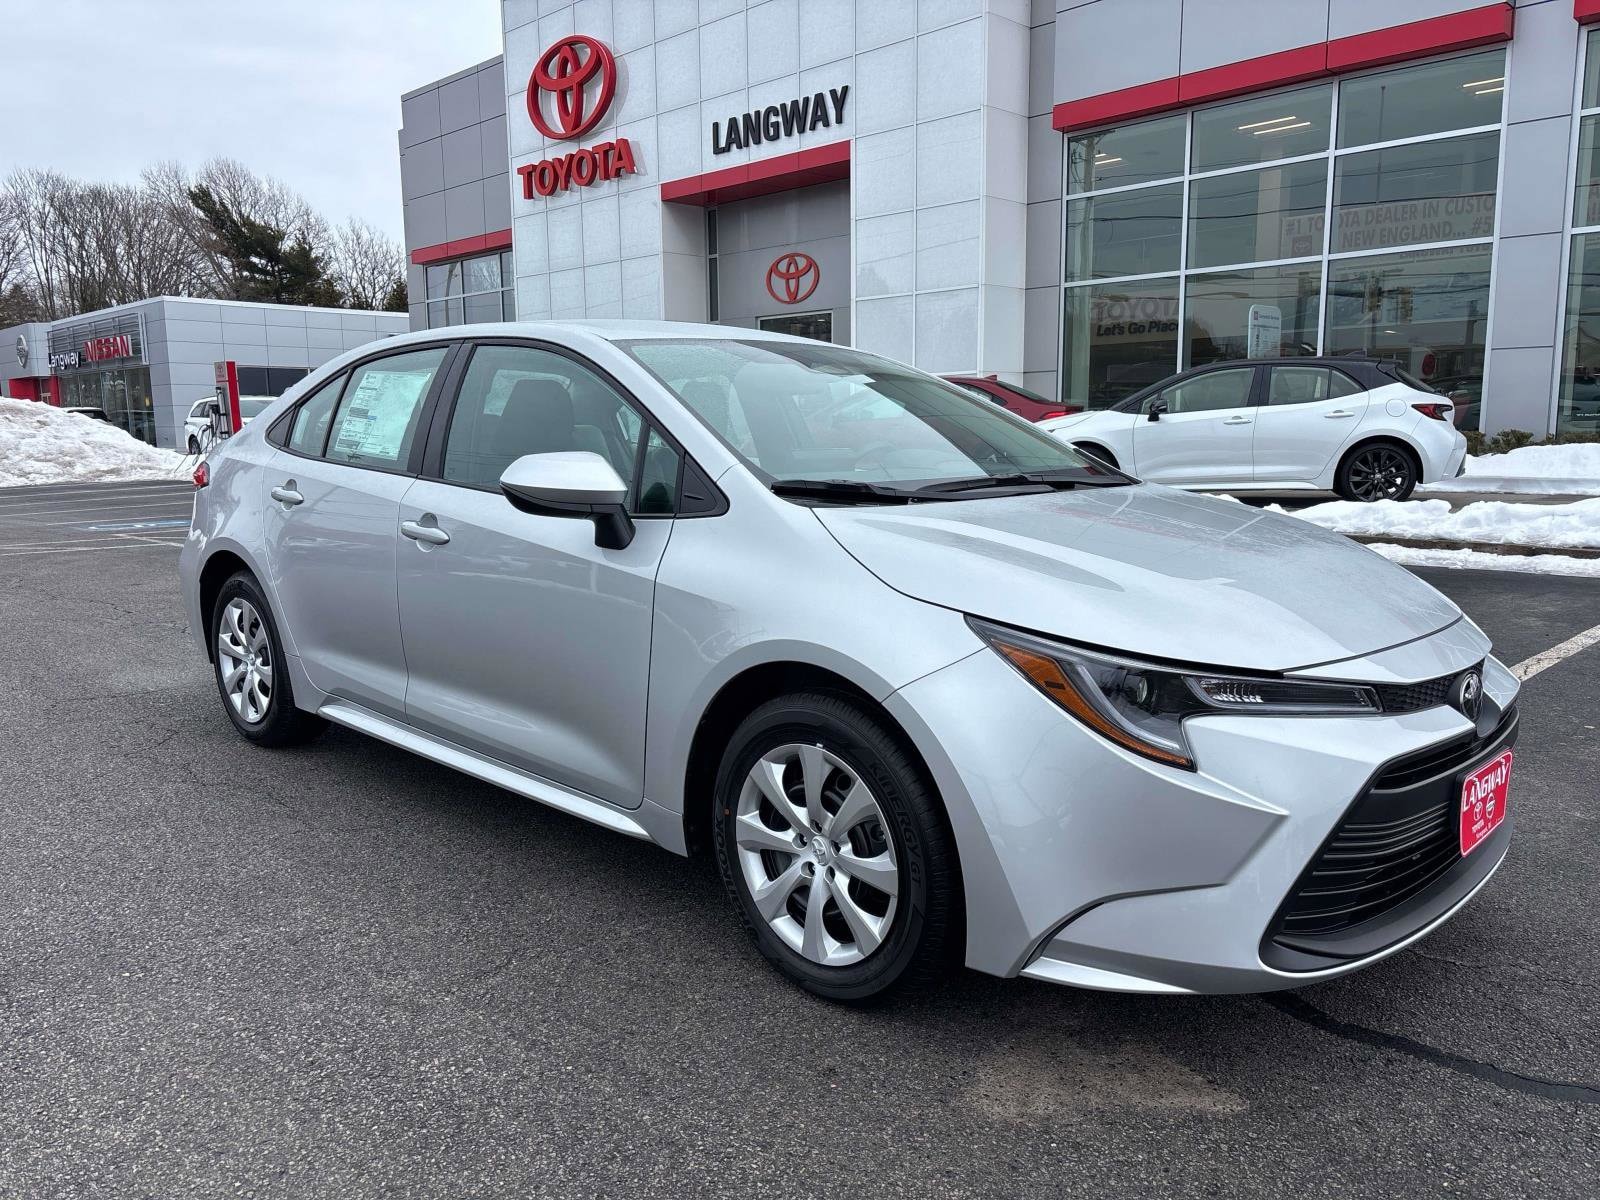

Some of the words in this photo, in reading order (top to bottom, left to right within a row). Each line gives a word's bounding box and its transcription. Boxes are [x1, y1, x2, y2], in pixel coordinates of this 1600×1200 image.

[711, 85, 849, 155] LANGWAY
[517, 138, 637, 200] TOYOTA
[1308, 210, 1361, 233] TOTA
[1365, 202, 1418, 226] DEALER
[1422, 199, 1440, 218] IN
[1342, 228, 1375, 249] NEW
[1096, 321, 1125, 337] Let's
[1127, 321, 1146, 335] Go
[1147, 319, 1179, 333] Plac
[48, 351, 80, 370] Langway
[84, 335, 132, 362] NISSAN
[1463, 763, 1510, 812] LANGWAY
